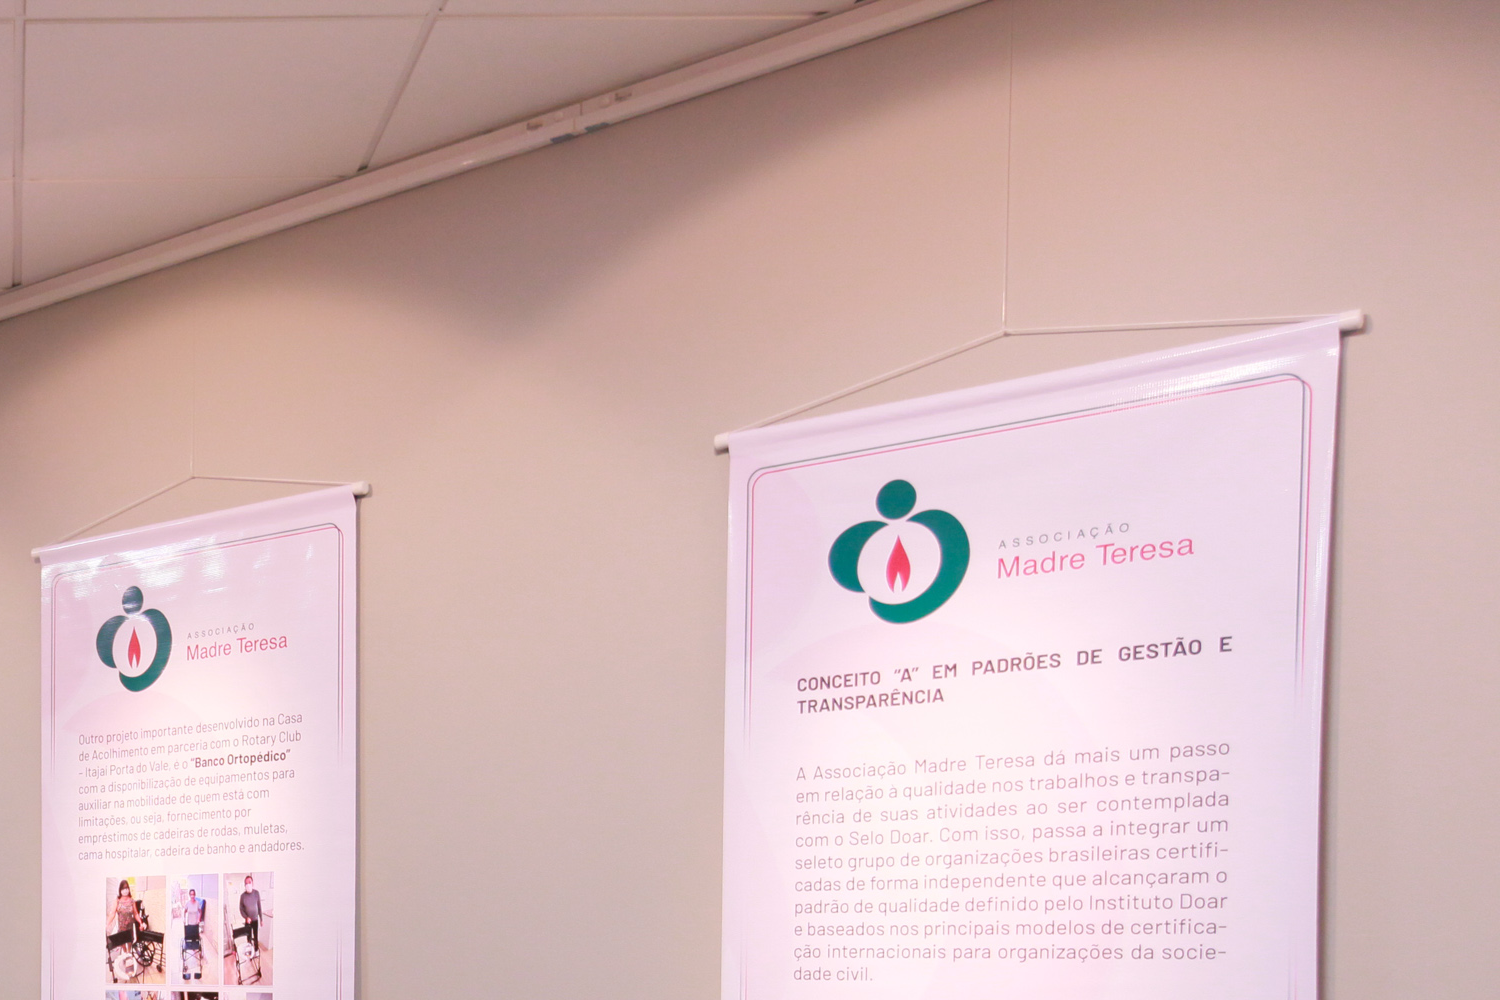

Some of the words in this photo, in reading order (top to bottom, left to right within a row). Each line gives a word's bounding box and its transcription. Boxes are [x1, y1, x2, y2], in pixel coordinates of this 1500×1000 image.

[998, 523, 1129, 549] ASSOCIAÇÃO
[998, 551, 1085, 578] Madre
[1096, 538, 1194, 565] Teresa
[187, 642, 231, 660] Madre
[236, 636, 287, 653] Teresa
[797, 671, 881, 692] CONCEITO
[933, 663, 957, 679] EM
[972, 652, 1061, 675] PADRÕES
[1077, 649, 1102, 666] DE
[1118, 637, 1202, 662] GESTÃO
[1220, 636, 1232, 652] E
[797, 688, 944, 714] TRANSPARÊNCIA
[79, 734, 104, 745] Outro
[106, 731, 138, 745] projeto
[141, 725, 193, 739] importante
[196, 717, 259, 733] desenvolvido
[263, 717, 275, 726] na
[278, 713, 302, 725] Casa
[79, 752, 89, 761] de
[92, 747, 148, 760] Acolhimento
[151, 745, 165, 755] em
[168, 740, 208, 755] parceria
[210, 739, 230, 749] com
[233, 738, 239, 747] o
[242, 735, 276, 746] Rotary
[279, 730, 301, 743] Club
[110, 765, 134, 775] Porta
[136, 763, 147, 773] do
[182, 761, 188, 769] o
[796, 767, 806, 780] A
[813, 761, 906, 779] Associação
[915, 758, 966, 773] Madre
[975, 755, 1034, 769] Teresa
[1044, 751, 1065, 766] dá
[1075, 747, 1120, 763] mais
[1130, 748, 1159, 761] um
[1170, 743, 1230, 762] passo
[78, 785, 98, 795] com
[100, 785, 105, 793] a
[184, 776, 196, 786] de
[199, 771, 269, 786] equipamentos
[272, 769, 295, 782] para
[796, 792, 819, 803] em
[825, 786, 883, 801] relação
[889, 787, 897, 798] à
[903, 780, 986, 800] qualidade
[992, 780, 1023, 792] nos
[1030, 773, 1118, 790] trabalhos
[1125, 774, 1135, 786] e
[1142, 769, 1229, 786] transpa-
[78, 799, 111, 811] auxiliar
[114, 800, 125, 808] na
[127, 794, 177, 807] mobilidade
[179, 794, 191, 804] de
[194, 793, 220, 805] quem
[247, 789, 269, 799] com
[796, 810, 844, 825] rência
[853, 809, 872, 823] de
[880, 809, 918, 821] suas
[927, 802, 1017, 819] atividades
[1026, 803, 1048, 815] ao
[1058, 801, 1087, 813] ser
[1097, 791, 1229, 812] contemplada
[130, 816, 141, 824] ou
[167, 809, 231, 821] fornecimento
[235, 808, 251, 820] por
[140, 831, 151, 840] de
[154, 828, 195, 840] cadeiras
[197, 827, 208, 838] de
[795, 836, 828, 848] com
[835, 835, 843, 846] o
[849, 831, 884, 846] Selo
[890, 829, 932, 844] Doar.
[940, 827, 978, 842] Com
[985, 826, 1024, 840] isso,
[1033, 826, 1086, 842] passa
[1093, 825, 1103, 837] a
[1111, 820, 1190, 838] integrar
[1197, 820, 1228, 833] um
[78, 851, 103, 860] cama
[155, 845, 190, 857] cadeira
[193, 845, 204, 855] de
[207, 843, 236, 854] banho
[239, 844, 245, 853] e
[248, 841, 304, 853] andadores.
[795, 856, 843, 870] seleto
[848, 856, 895, 872] grupo
[900, 853, 920, 867] de
[925, 849, 1043, 869] organizações
[1049, 845, 1150, 862] brasileiras
[1156, 842, 1228, 859] certifi-
[795, 878, 841, 892] cadas
[846, 877, 865, 891] de
[871, 876, 918, 890] forma
[924, 873, 1046, 892] independente
[1052, 875, 1086, 889] que
[1092, 870, 1209, 888] alcançaram
[1216, 871, 1227, 883] o
[795, 900, 849, 917] padrão
[854, 900, 873, 913] de
[878, 898, 959, 916] qualidade
[965, 896, 1038, 912] definido
[1045, 896, 1083, 914] pelo
[1090, 894, 1173, 910] Instituto
[1180, 893, 1228, 909] Doar
[794, 925, 802, 936] e
[808, 922, 884, 936] baseados
[890, 925, 919, 936] nos
[924, 920, 1010, 938] principais
[1016, 920, 1095, 935] modelos
[1101, 920, 1124, 935] de
[1131, 919, 1227, 935] certifica-
[794, 945, 821, 961] ção
[828, 944, 946, 959] internacionais
[953, 948, 991, 962] para
[998, 944, 1123, 963] organizações
[1131, 944, 1154, 959] da
[1162, 944, 1226, 960] socie-
[794, 967, 831, 980] dade
[837, 967, 873, 981] civil.
